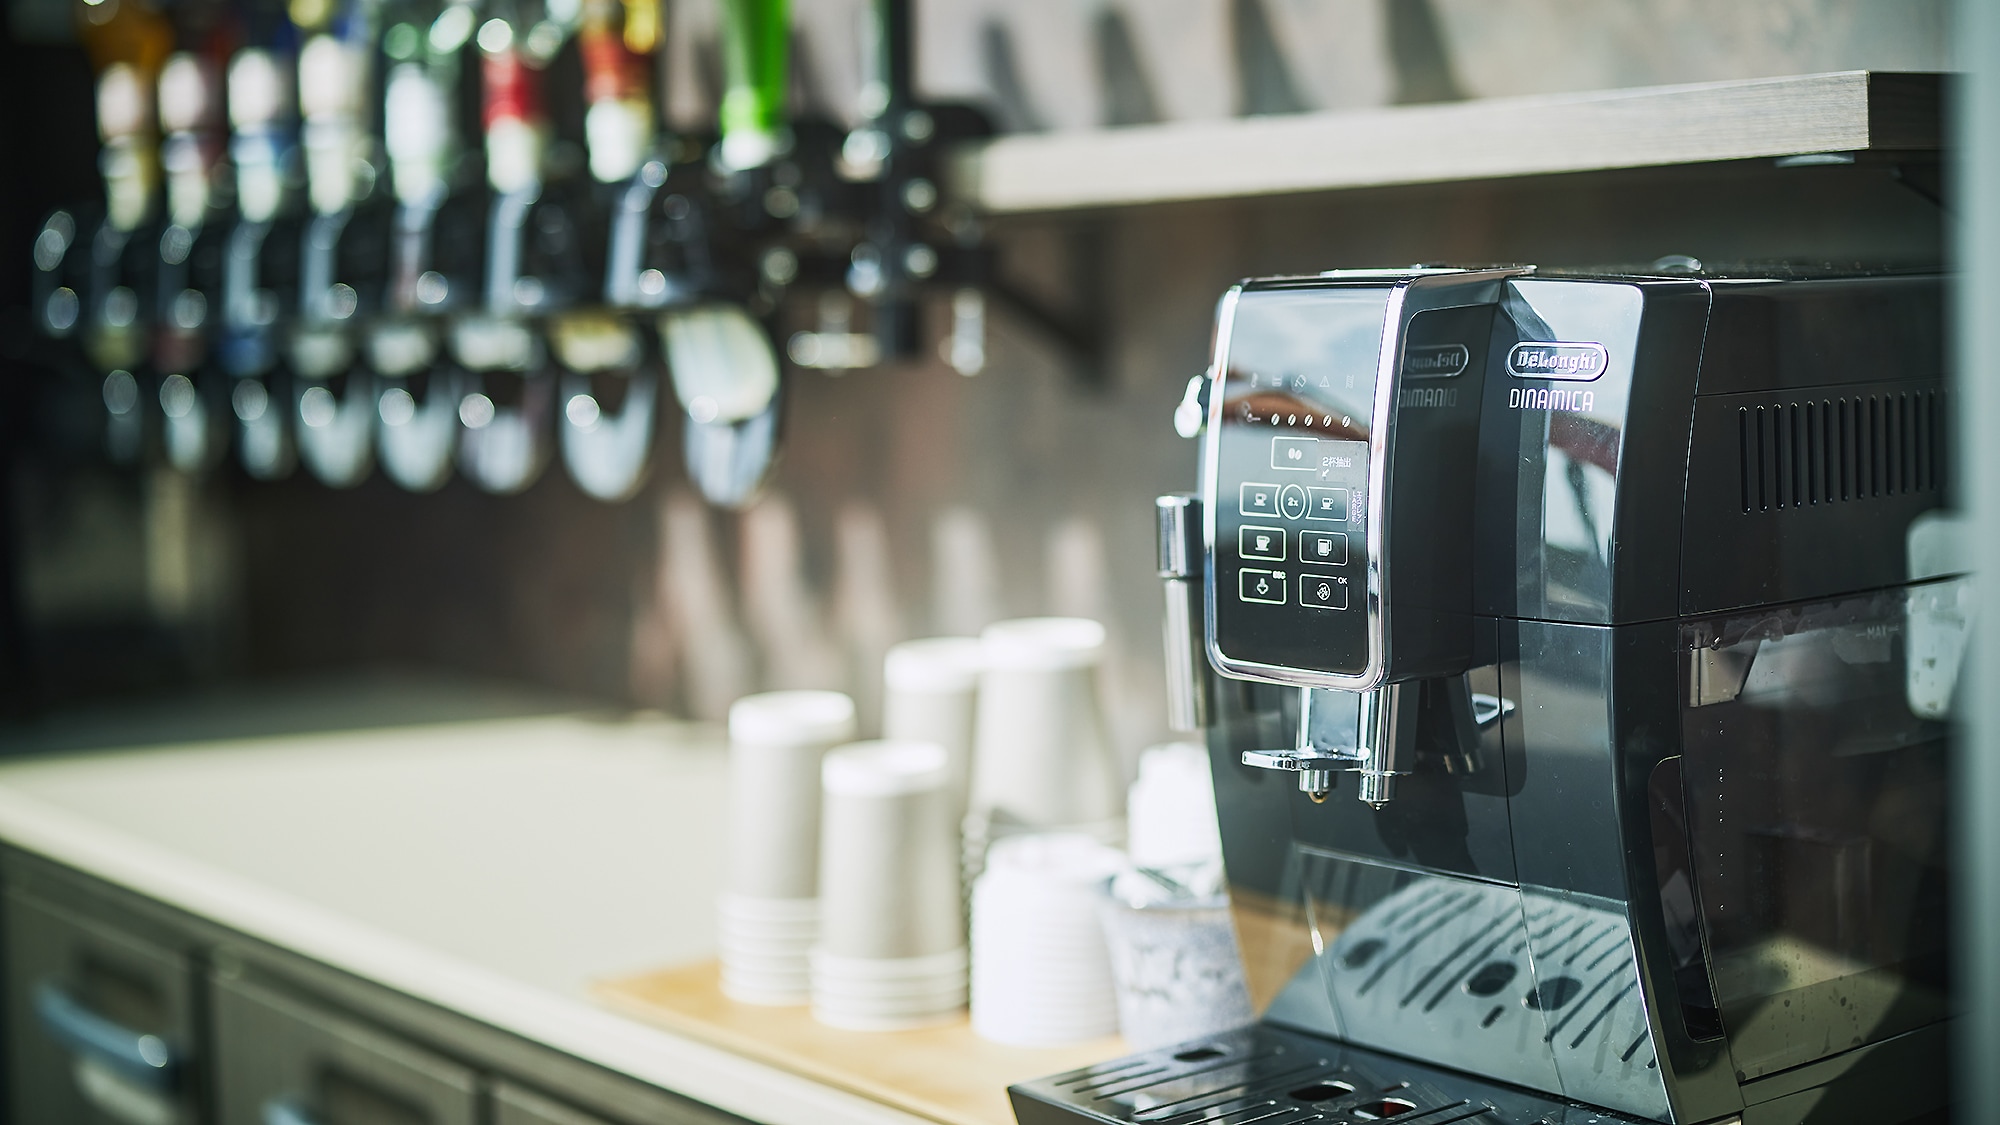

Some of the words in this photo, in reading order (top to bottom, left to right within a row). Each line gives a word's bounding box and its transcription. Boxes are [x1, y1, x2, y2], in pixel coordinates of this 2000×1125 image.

[1508, 388, 1595, 412] DINAMICA
[1322, 456, 1352, 468] 2杯抽出
[1337, 576, 1348, 585] OK
